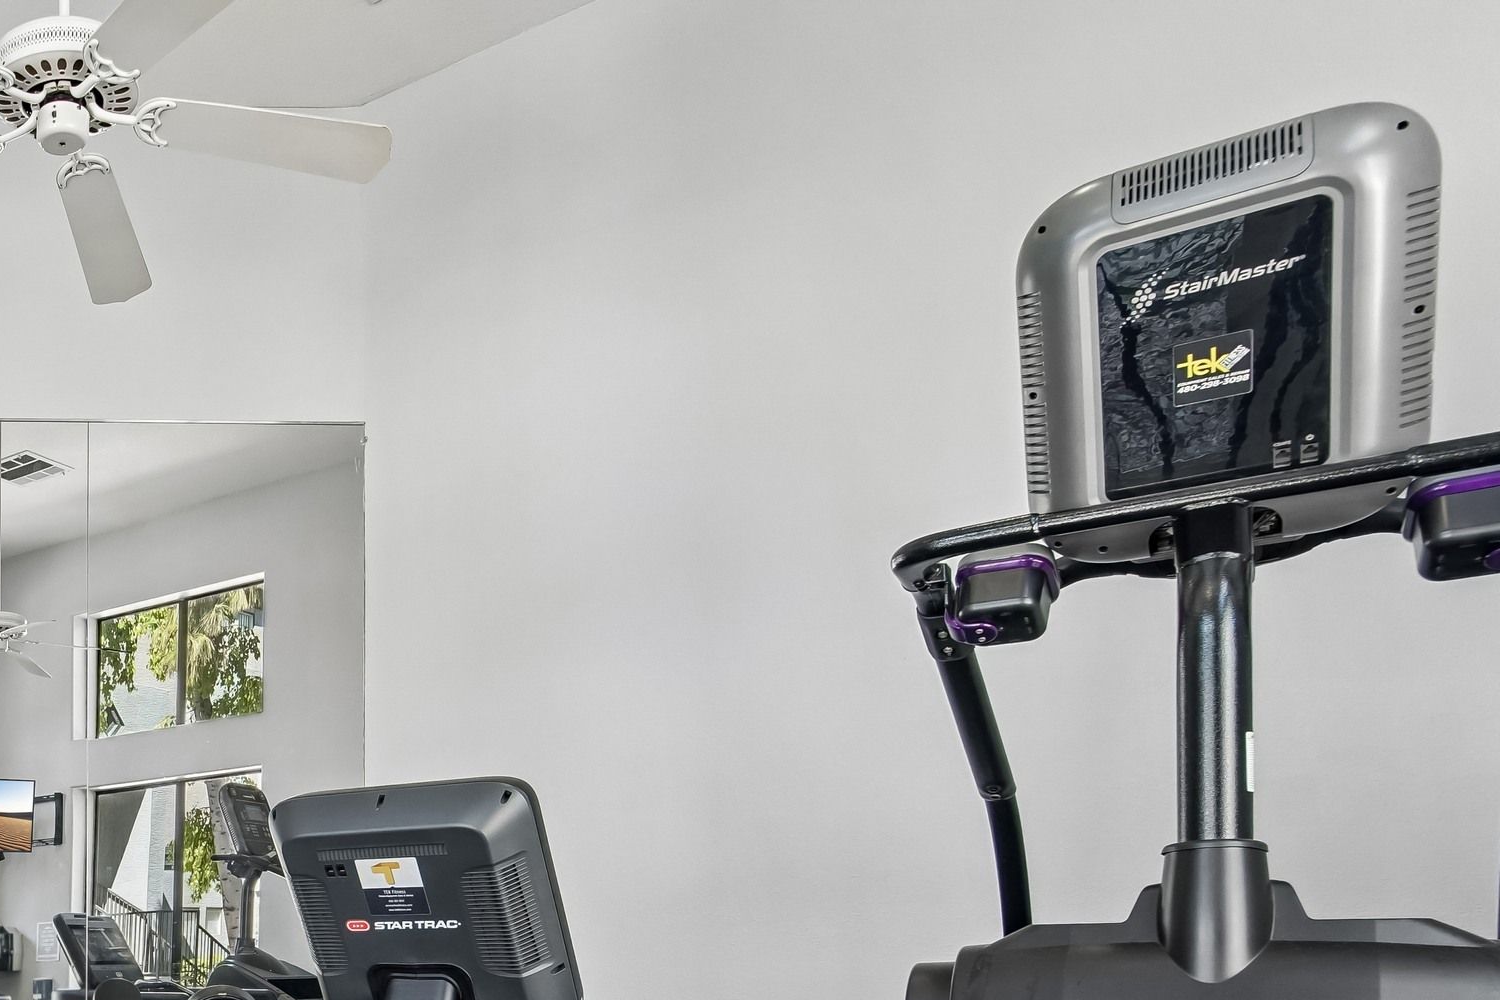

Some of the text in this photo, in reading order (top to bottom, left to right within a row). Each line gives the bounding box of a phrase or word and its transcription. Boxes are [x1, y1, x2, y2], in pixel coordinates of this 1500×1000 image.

[1163, 256, 1301, 300] StairMaster
[1176, 346, 1230, 378] tek
[1176, 374, 1250, 394] 480-298-3098
[374, 920, 458, 930] STAR TRAC
